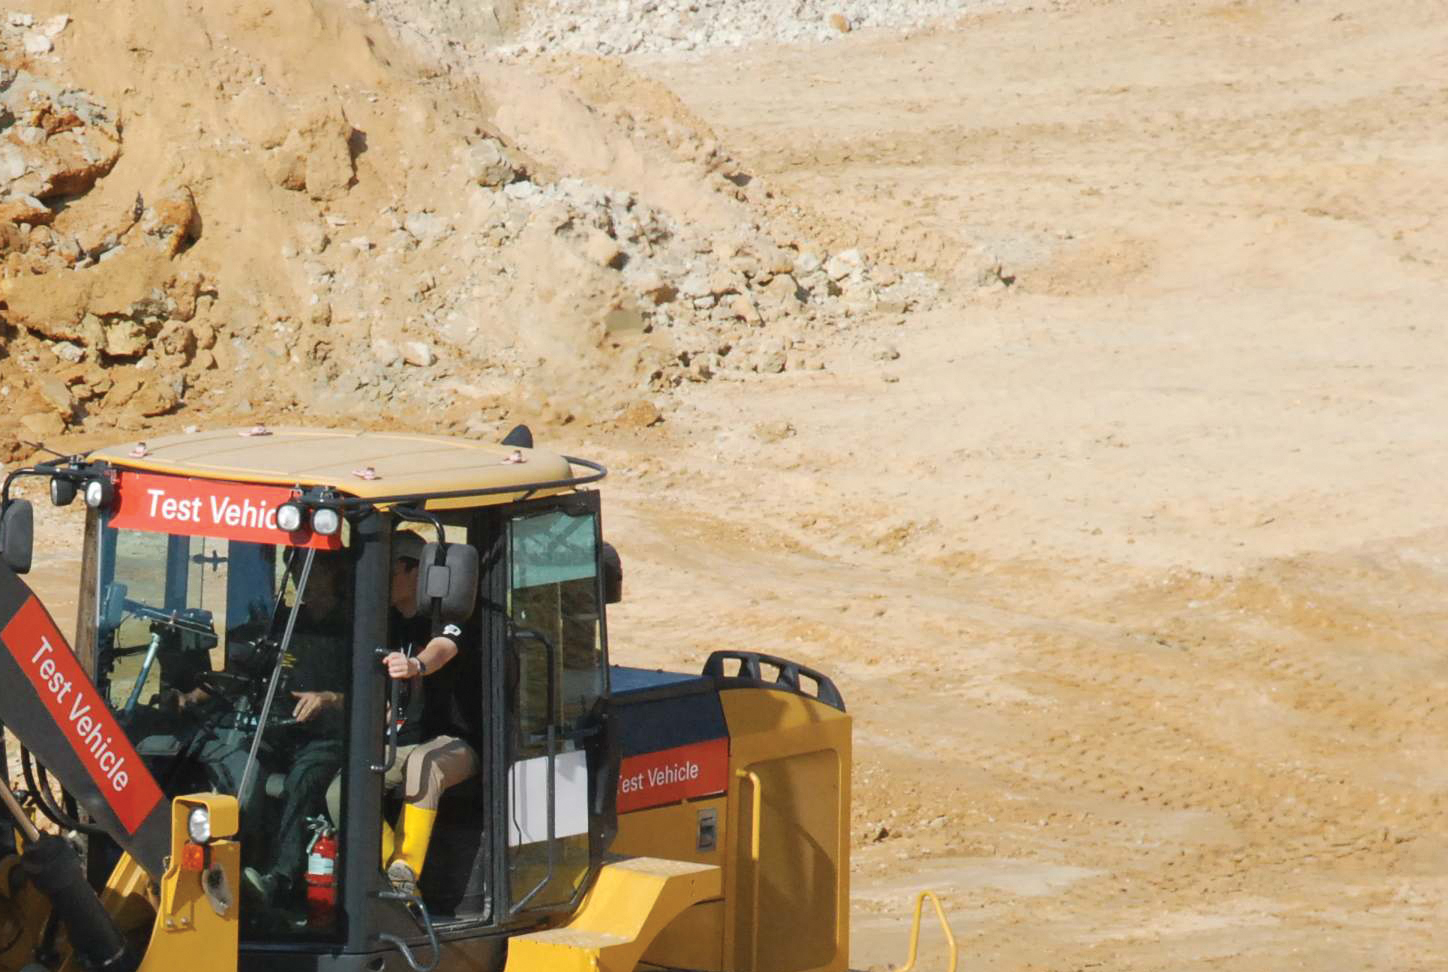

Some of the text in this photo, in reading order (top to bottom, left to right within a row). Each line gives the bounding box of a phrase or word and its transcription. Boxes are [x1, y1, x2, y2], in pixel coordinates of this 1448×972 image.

[147, 489, 279, 529] Test Vehic
[31, 635, 129, 792] Test Vehicle
[617, 761, 699, 794] est Vehicle
